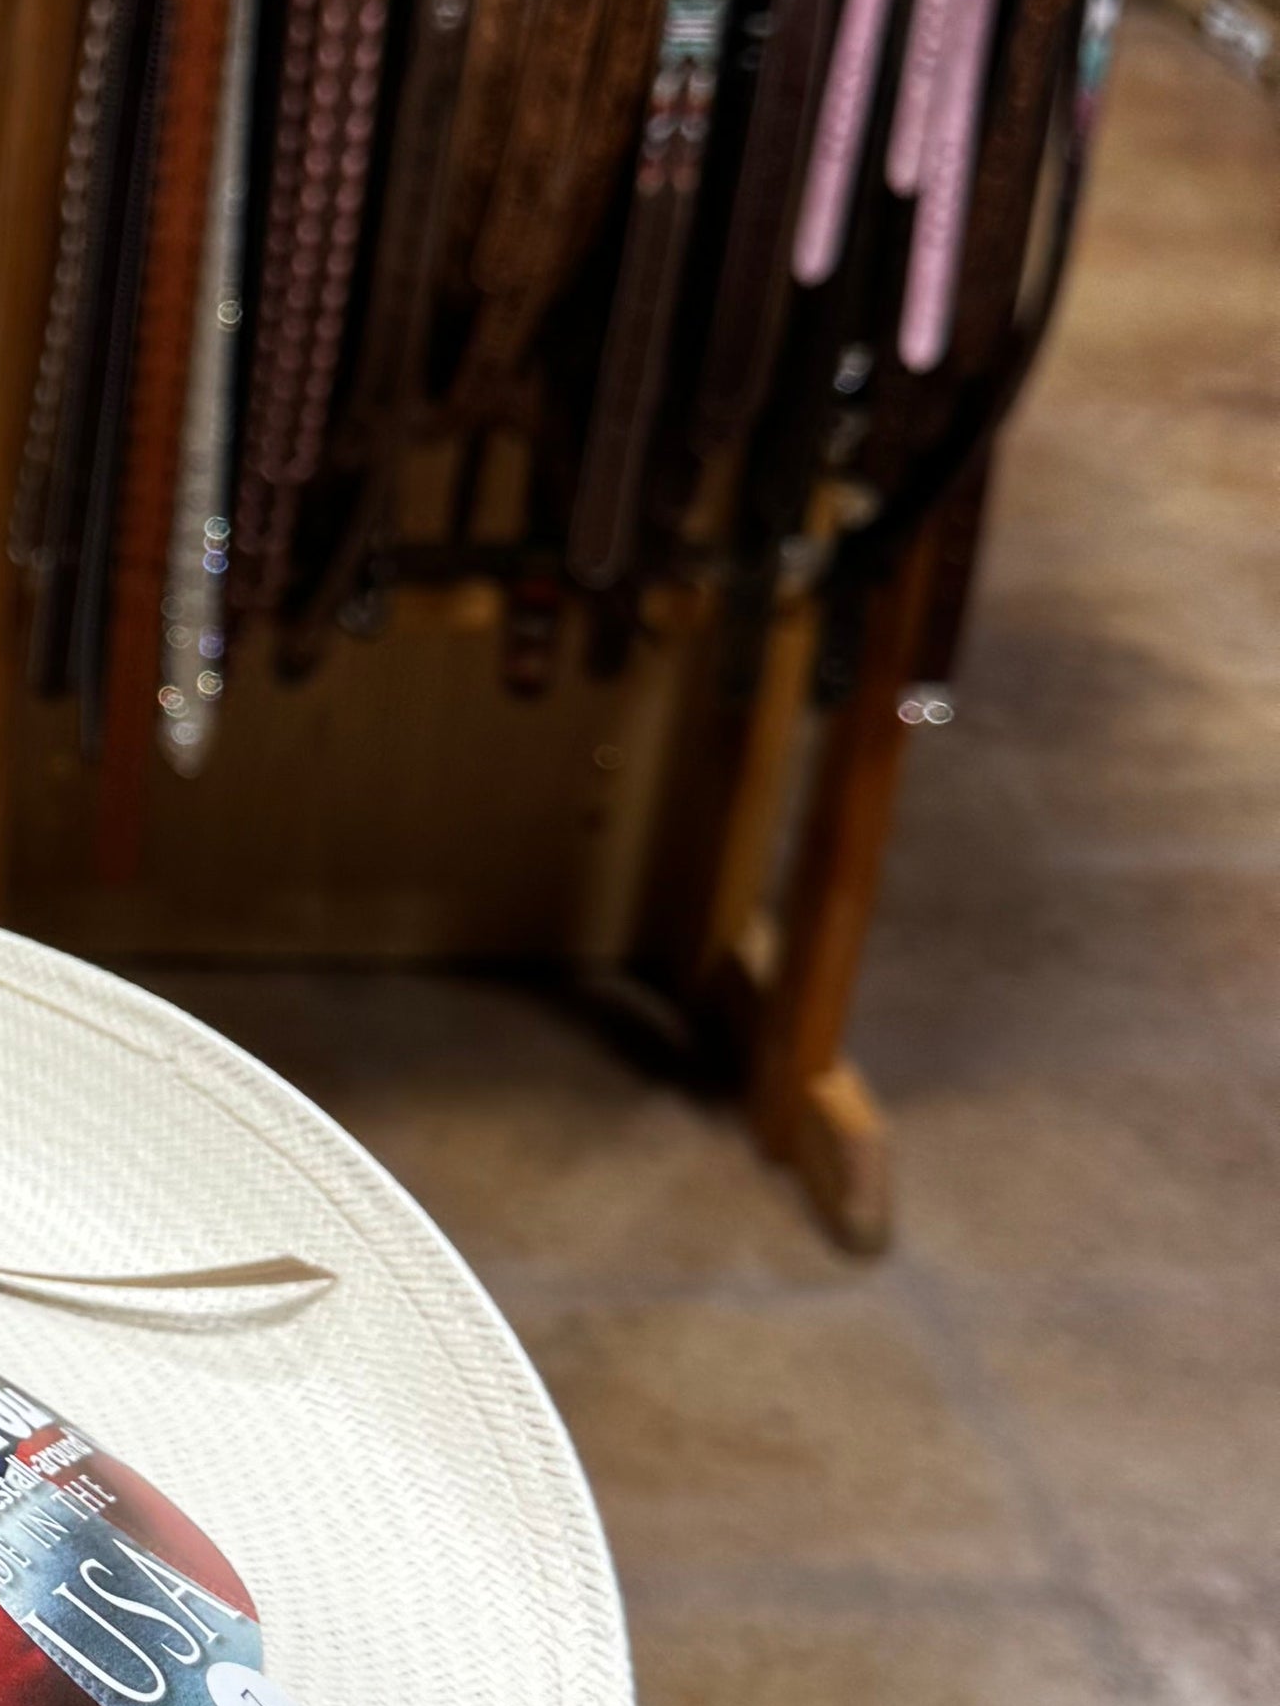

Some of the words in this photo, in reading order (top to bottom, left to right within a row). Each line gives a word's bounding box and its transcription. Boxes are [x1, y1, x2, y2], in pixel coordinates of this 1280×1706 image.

[16, 1505, 71, 1550] IN
[49, 1473, 118, 1521] THE
[22, 1537, 242, 1703] USA
